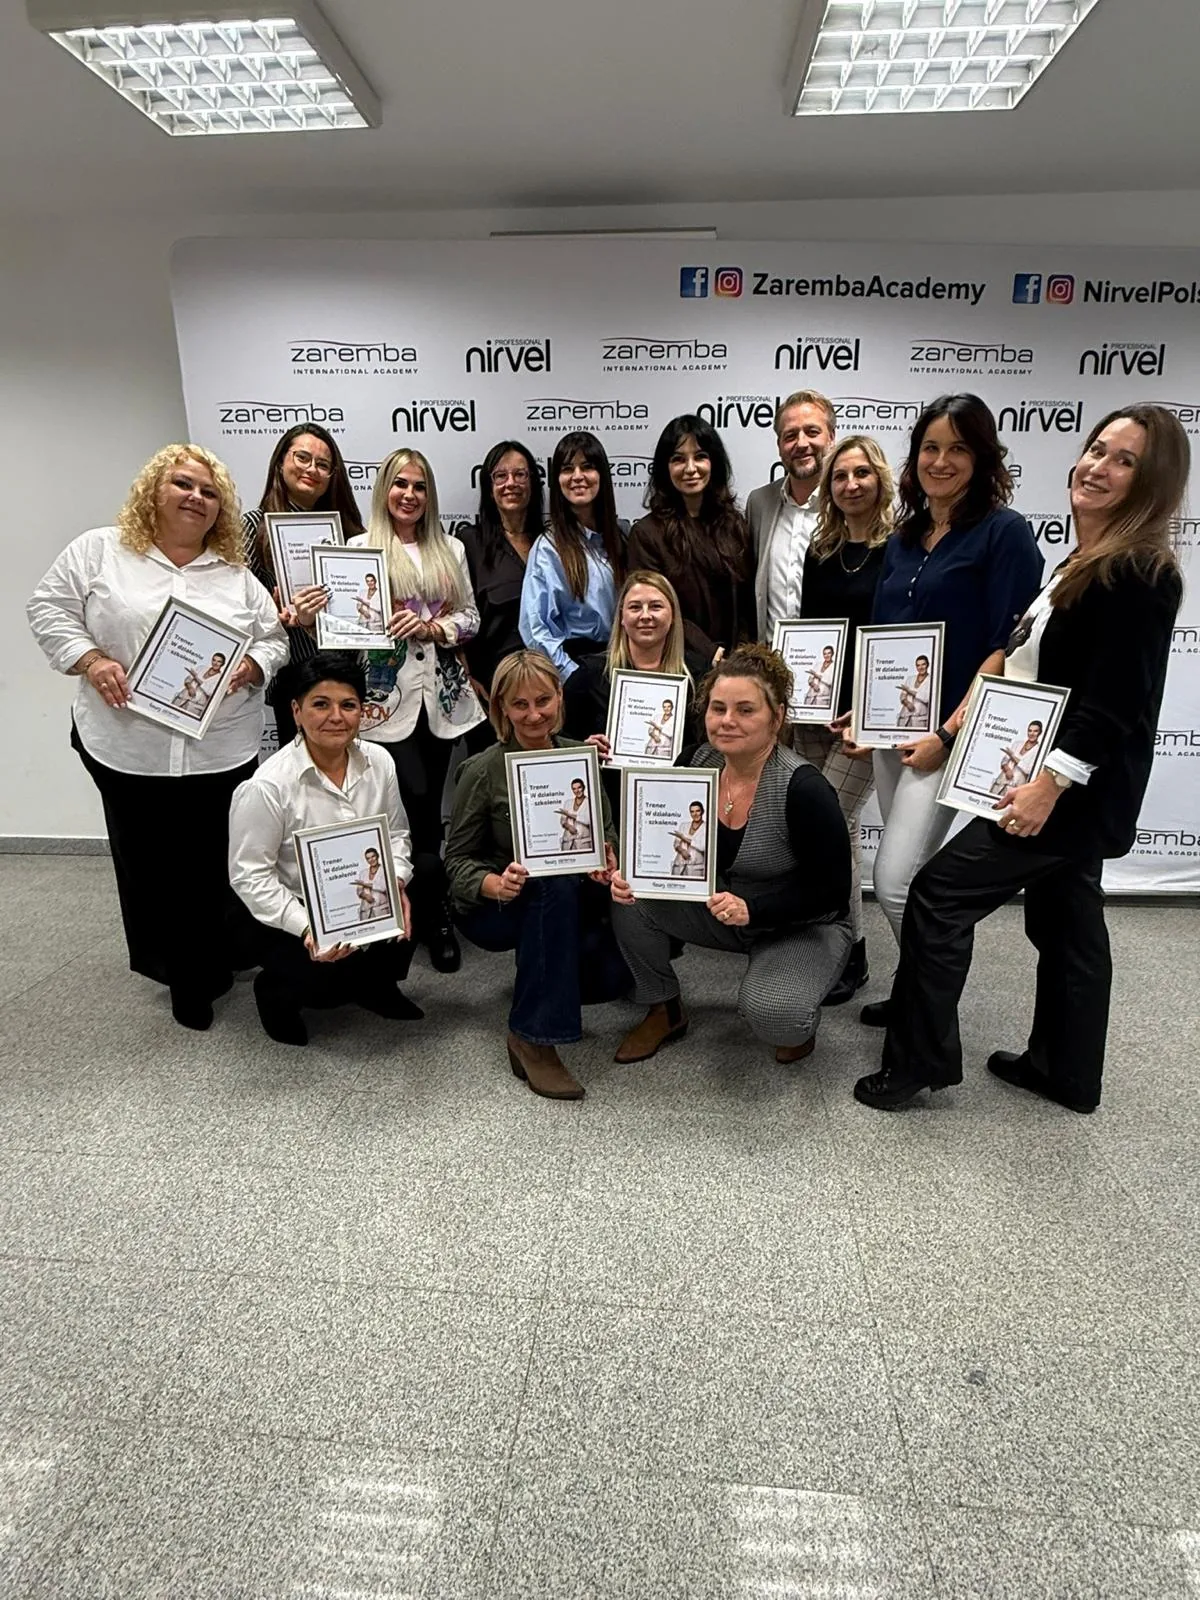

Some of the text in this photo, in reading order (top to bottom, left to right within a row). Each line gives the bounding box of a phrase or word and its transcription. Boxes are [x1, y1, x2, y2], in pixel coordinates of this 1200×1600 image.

[752, 272, 986, 305] ZarembaAcademy
[291, 343, 418, 362] zaremba
[466, 339, 551, 373] nirvel
[602, 339, 727, 359] zaremba
[775, 337, 860, 371] nirvel
[910, 343, 1033, 363] zaremba
[1079, 343, 1166, 376] nirvel
[219, 403, 344, 423] zaremba
[392, 400, 476, 432] nirvel
[526, 400, 649, 420] zaremba
[696, 396, 781, 428] nirvel
[998, 401, 1083, 433] nirvel
[835, 423, 904, 431] NTERNATIONAL
